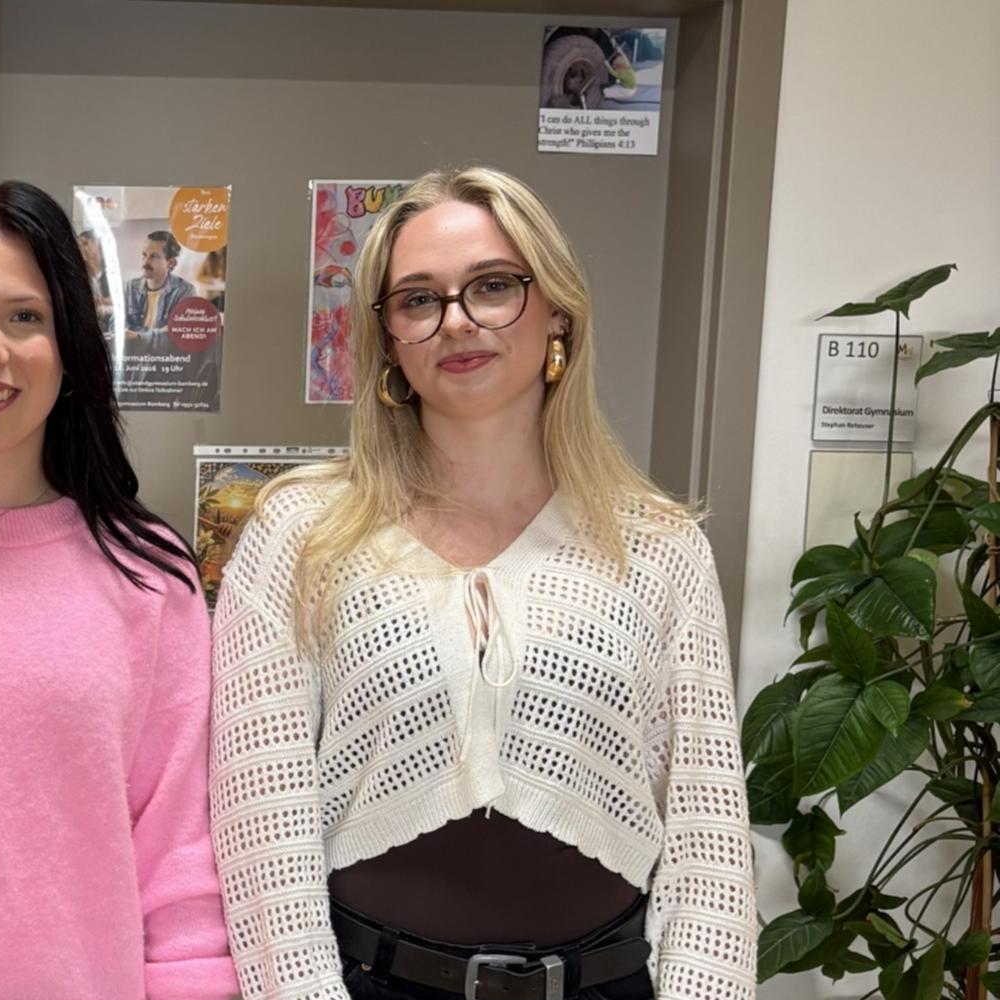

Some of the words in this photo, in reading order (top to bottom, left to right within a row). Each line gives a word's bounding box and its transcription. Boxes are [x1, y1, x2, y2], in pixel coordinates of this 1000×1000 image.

[828, 340, 840, 357] B
[845, 340, 880, 359] 110
[112, 354, 191, 363] ormationsabend
[822, 405, 863, 416] Direktorat
